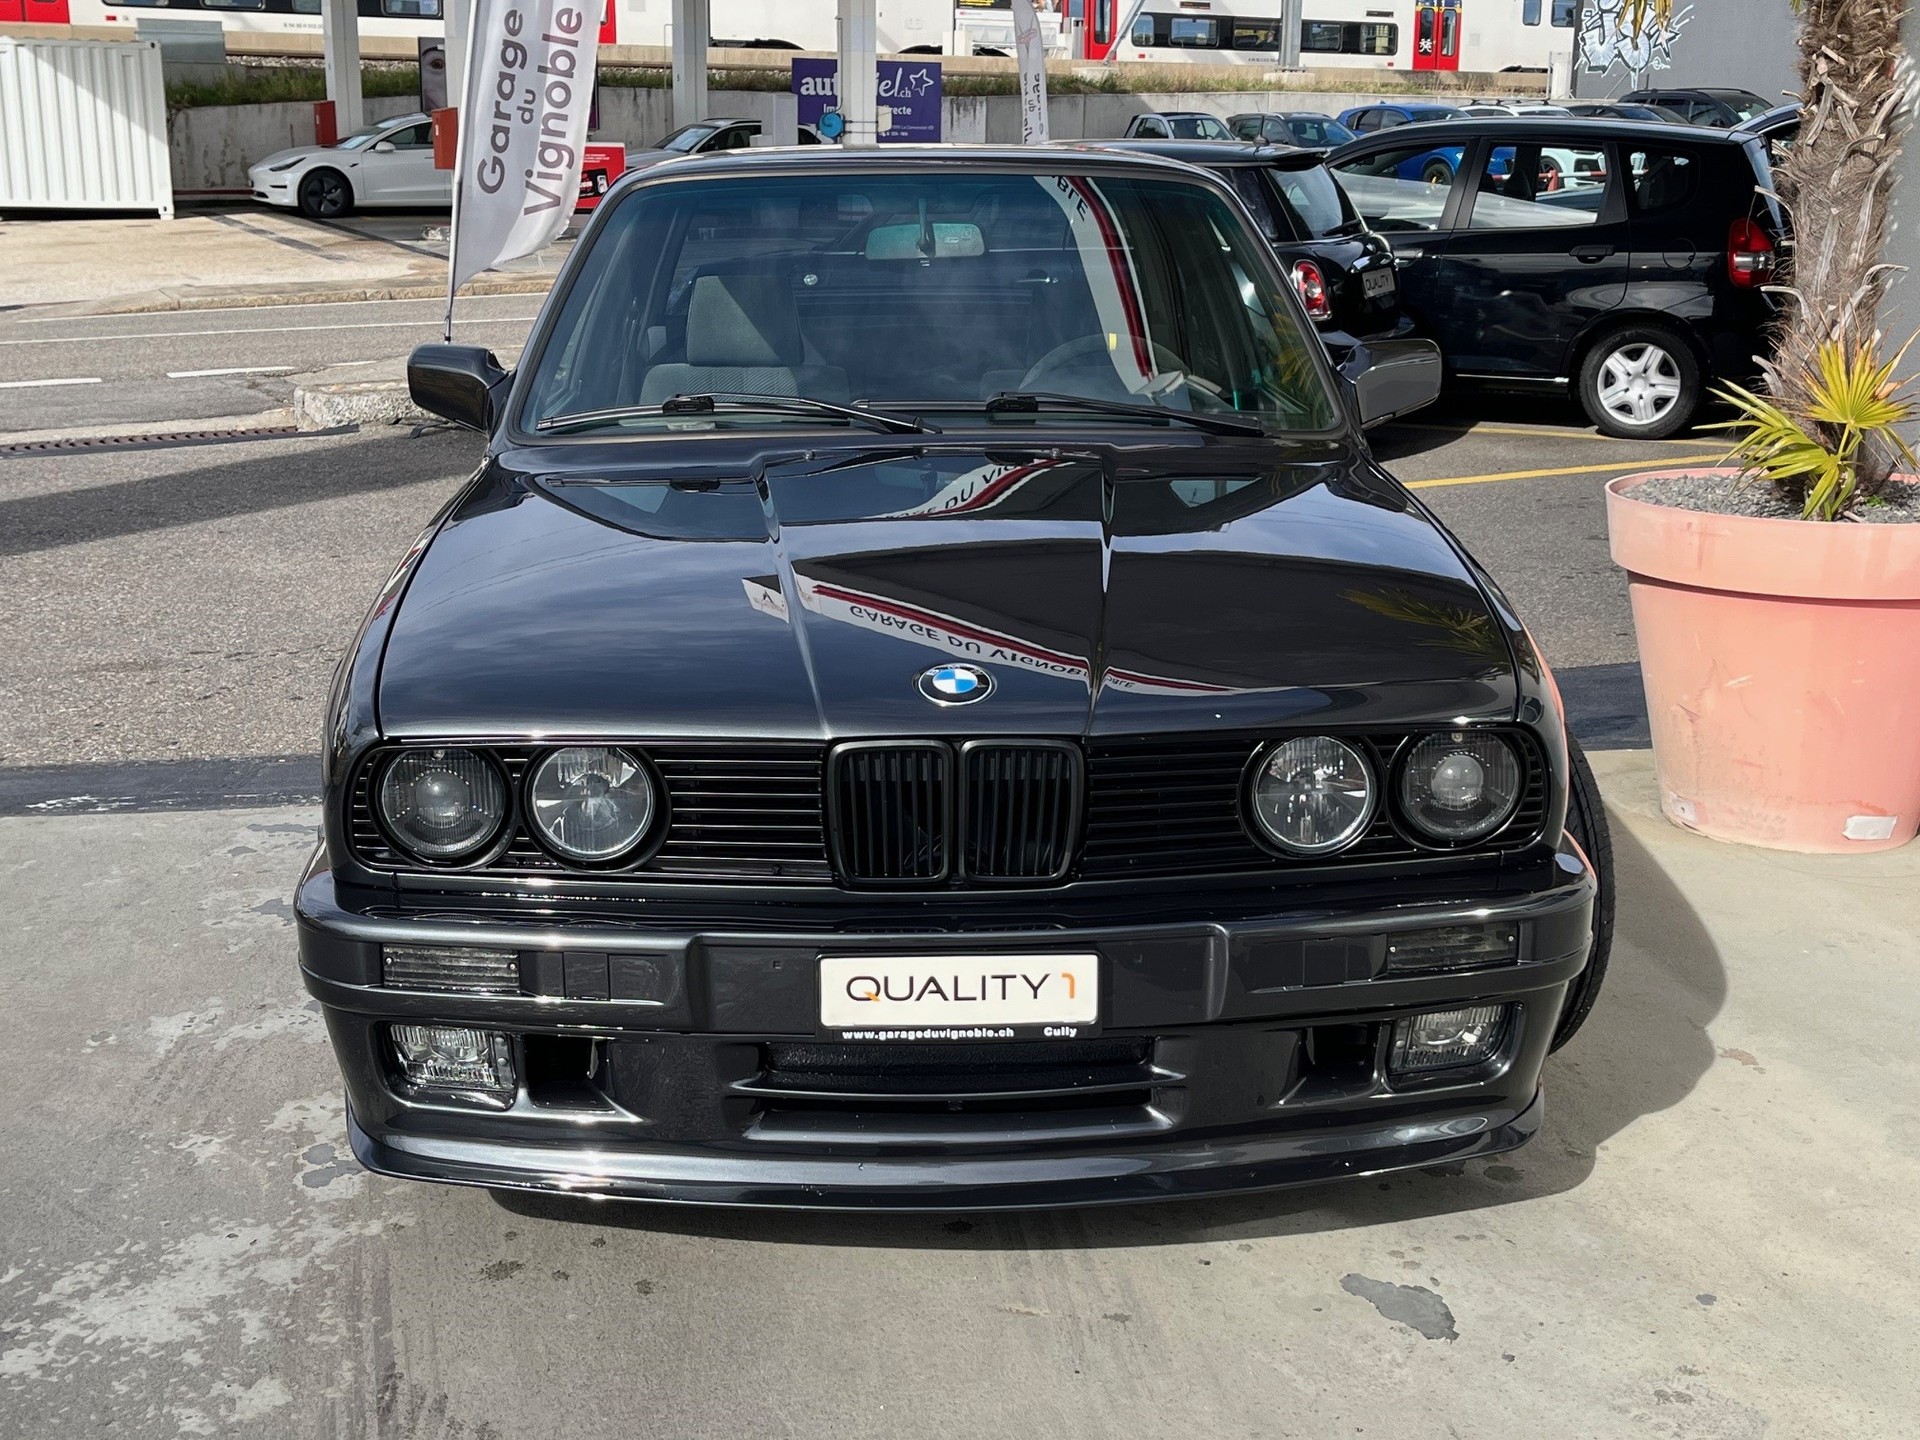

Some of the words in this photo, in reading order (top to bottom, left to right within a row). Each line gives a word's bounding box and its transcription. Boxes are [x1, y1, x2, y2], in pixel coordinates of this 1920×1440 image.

[477, 9, 528, 194] Garage
[517, 88, 536, 124] du
[524, 8, 583, 216] Vignoble
[1365, 274, 1389, 291] QUALITY
[846, 973, 1051, 1002] QUALITY
[1061, 971, 1075, 1000] 1
[842, 1027, 1014, 1041] www.garageduvignoble.ch
[1043, 1026, 1077, 1039] Cully
